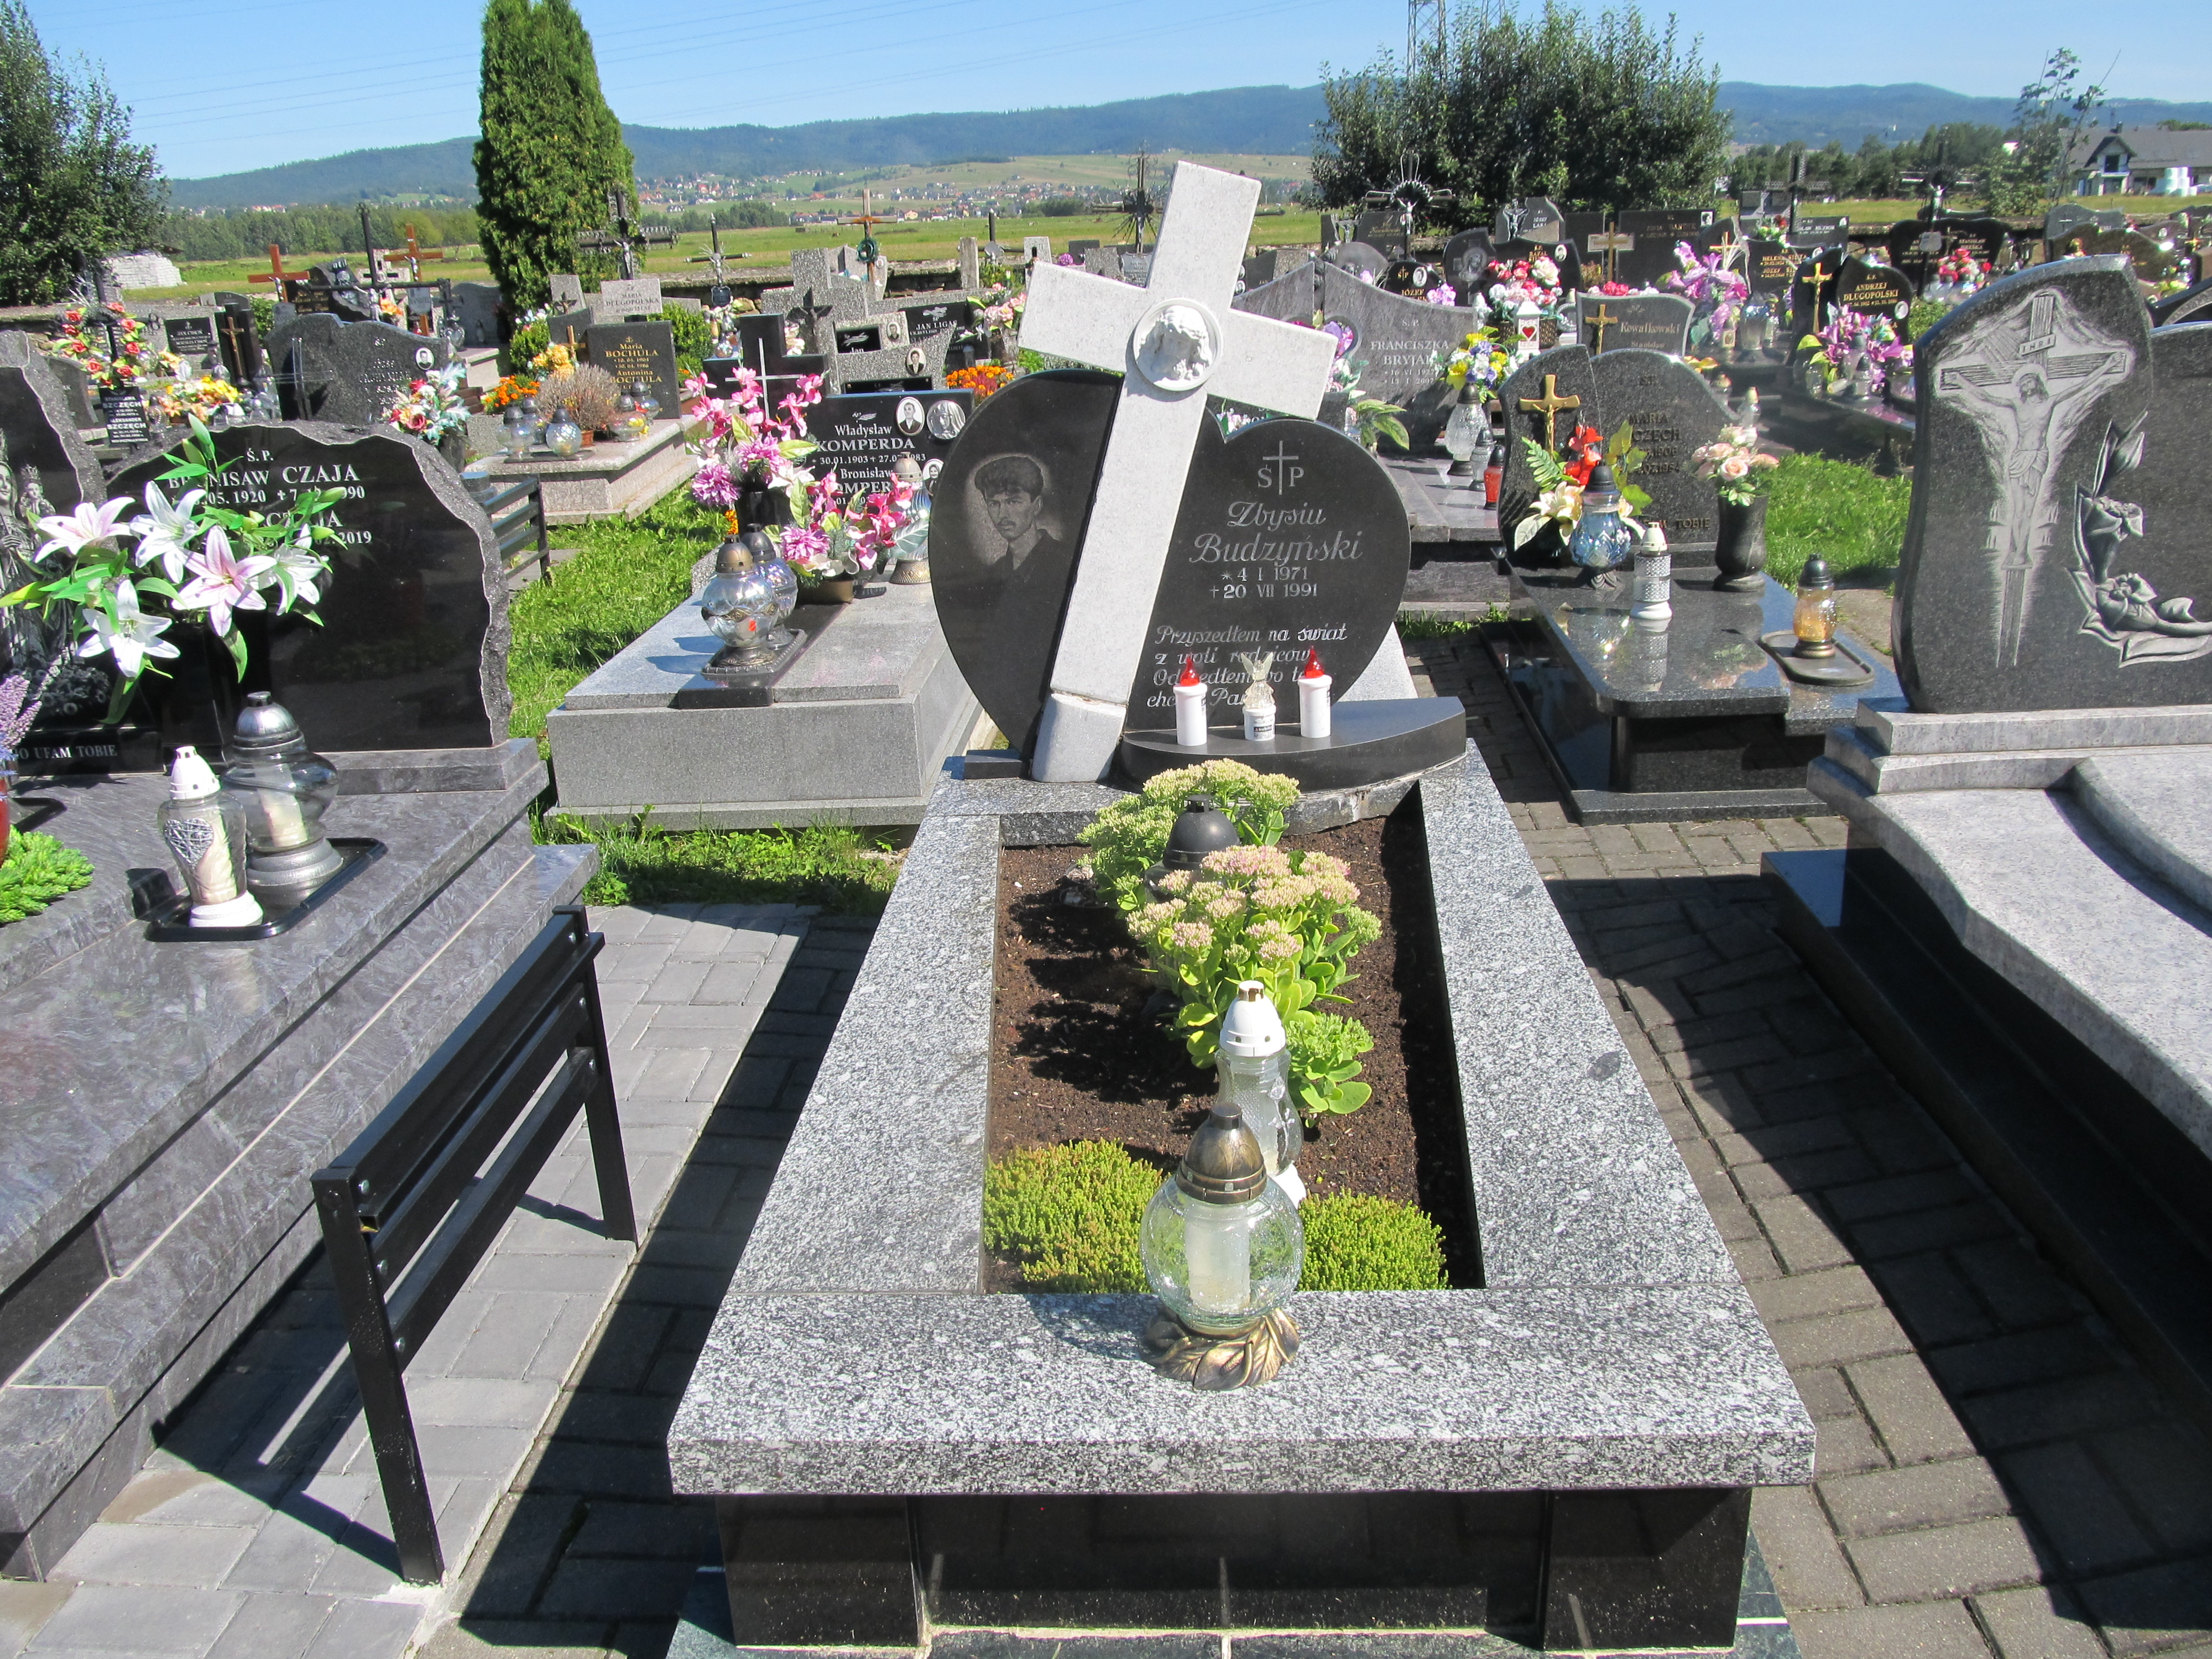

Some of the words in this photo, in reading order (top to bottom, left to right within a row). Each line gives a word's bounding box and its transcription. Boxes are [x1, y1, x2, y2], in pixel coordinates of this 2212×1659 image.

[1370, 340, 1449, 350] FRANCISZKA
[834, 422, 893, 439] Władysław
[816, 437, 916, 453] KOMPERDA
[168, 470, 270, 489] BRNISAW
[281, 463, 361, 484] CZAJA
[265, 510, 343, 528] CZJA
[1227, 500, 1327, 532] Zbysiu
[1676, 518, 1711, 528] TOBIE
[1188, 530, 1363, 567] Budzyński
[1237, 567, 1248, 581] 4
[1274, 566, 1308, 581] 1971
[1223, 583, 1248, 599] 20
[1256, 583, 1275, 598] VII
[1283, 582, 1318, 597] 1991
[1154, 624, 1261, 648] Przyszedłem
[1267, 629, 1290, 642] na
[1297, 623, 1348, 641] świat
[1177, 646, 1218, 664] woli
[1152, 667, 1252, 686] Odedłem
[34, 747, 73, 759] UFAM
[76, 744, 118, 758] TOBIE
